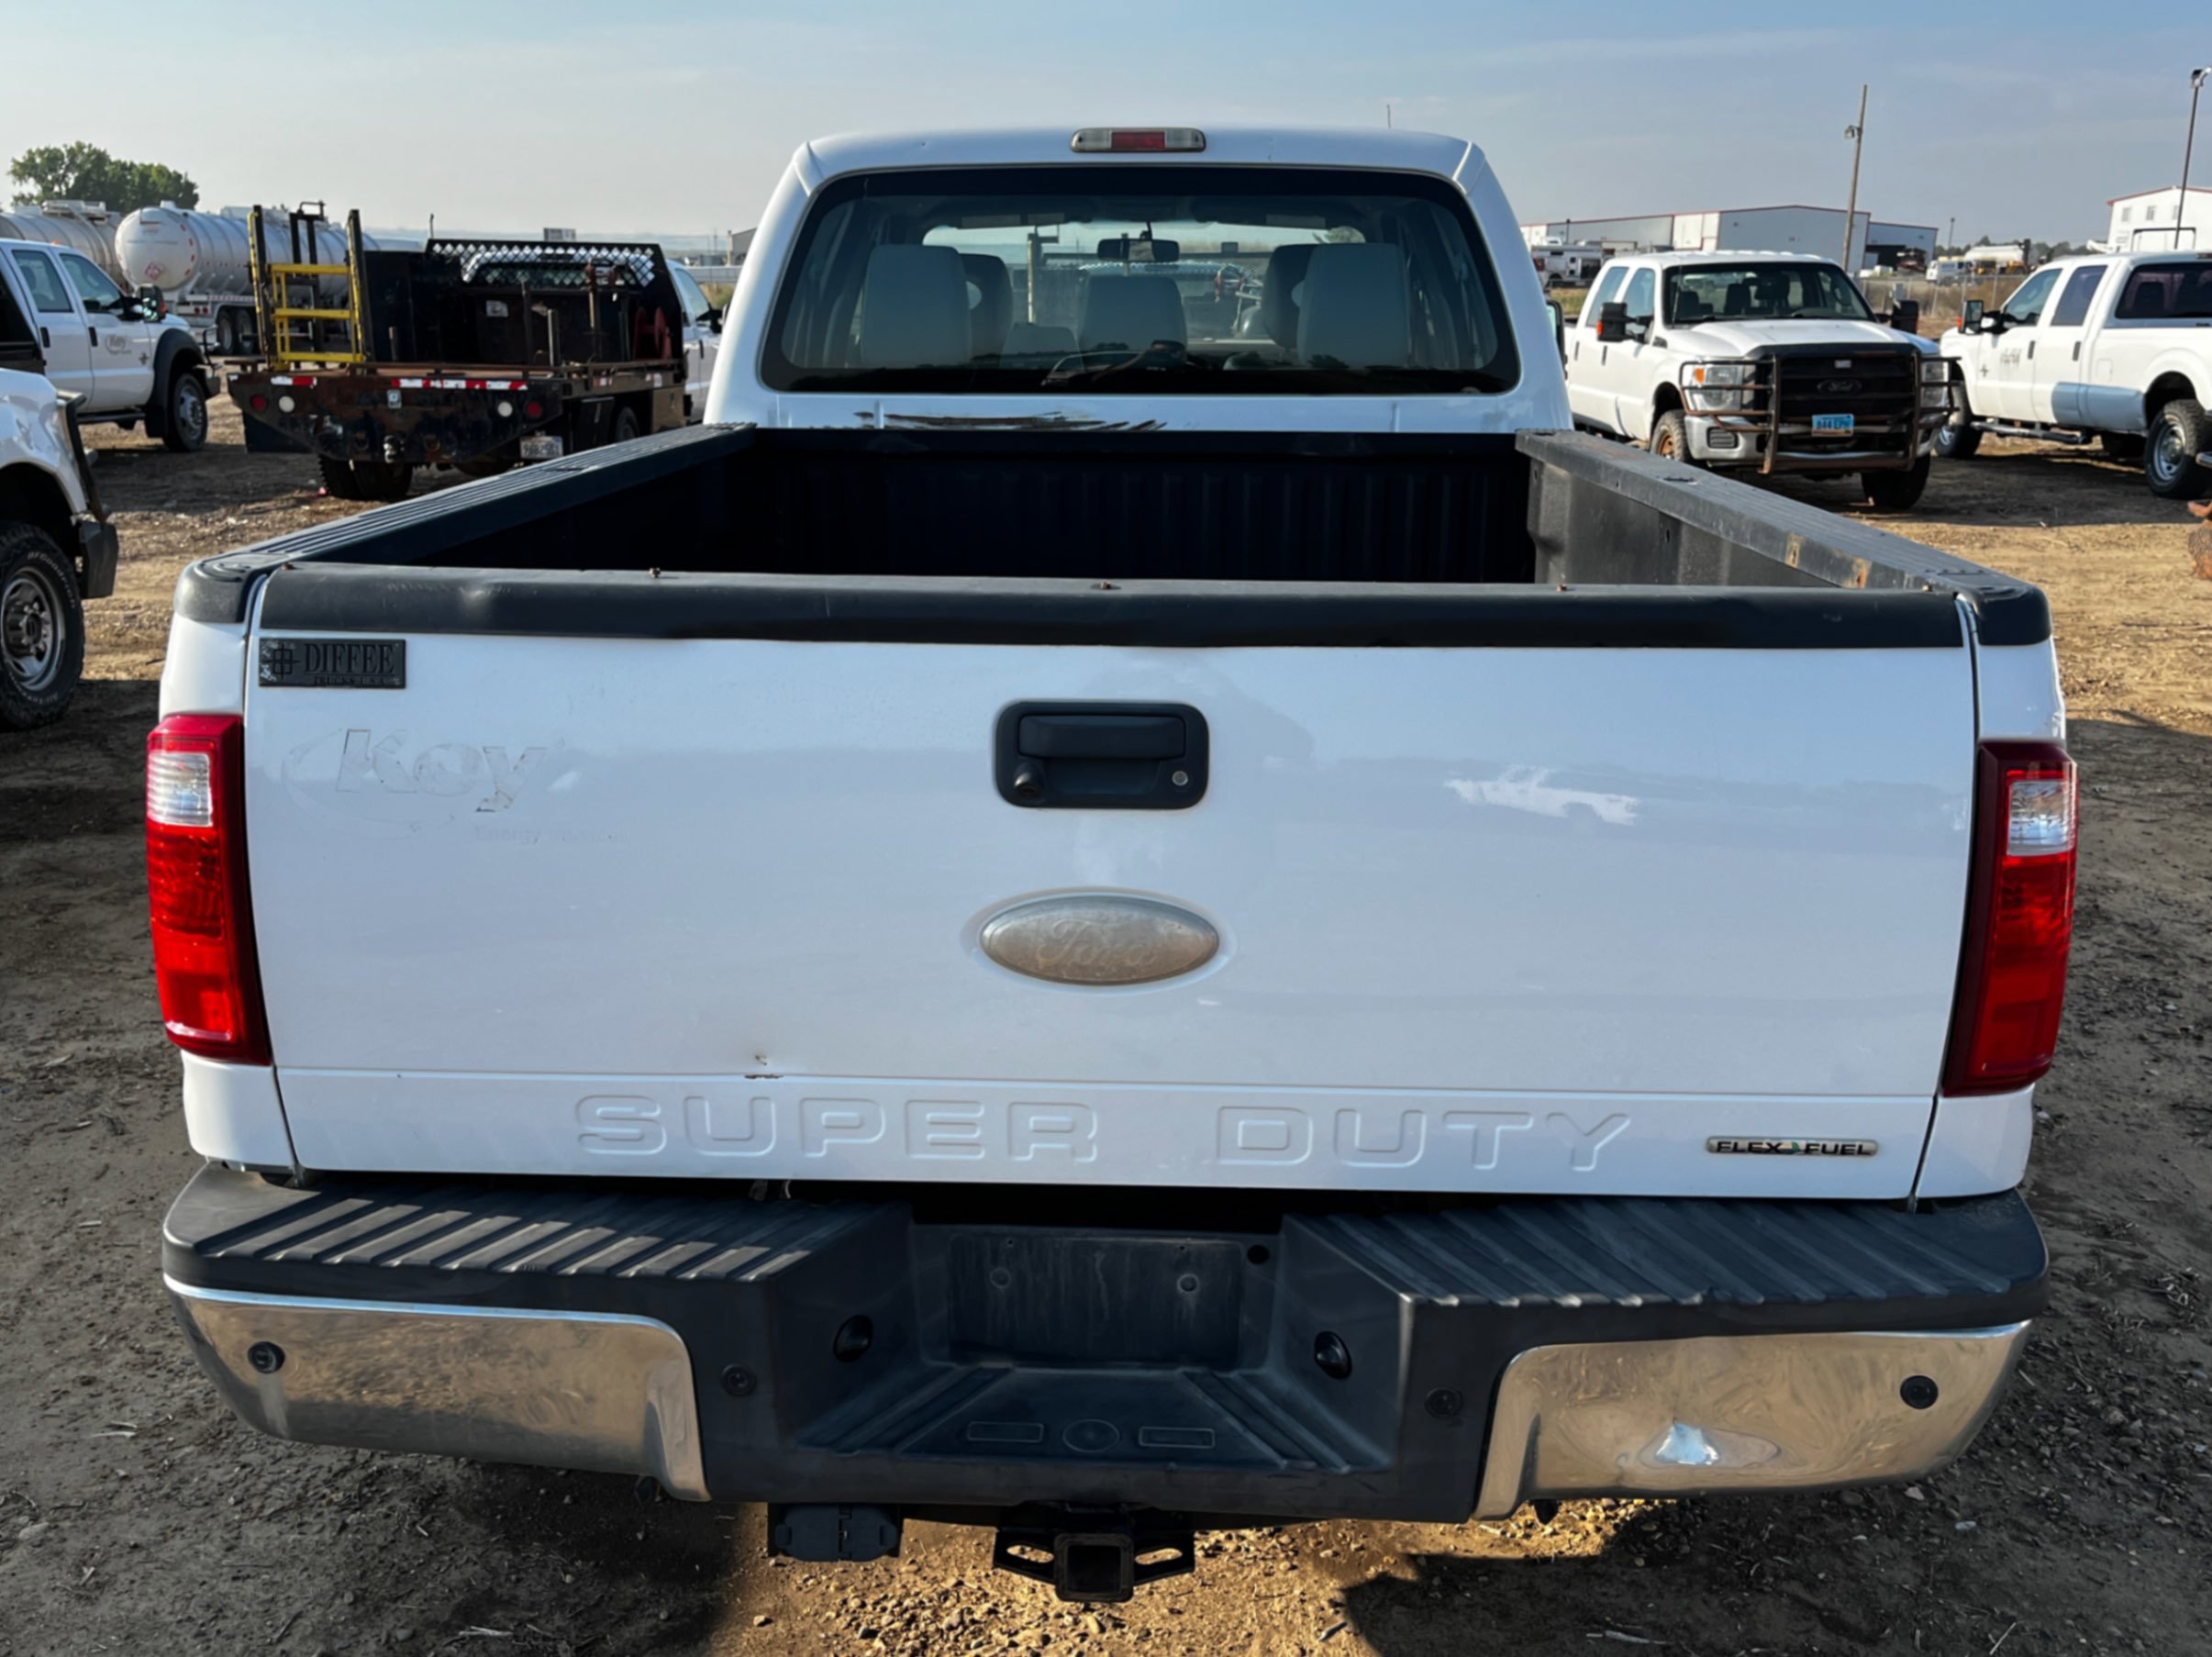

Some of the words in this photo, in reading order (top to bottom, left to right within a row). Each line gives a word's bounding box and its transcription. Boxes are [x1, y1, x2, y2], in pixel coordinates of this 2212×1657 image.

[304, 643, 395, 674] DIFFEE
[1035, 917, 1158, 969] Ford
[575, 1095, 1097, 1162] SUPER
[1217, 1106, 1631, 1172] DUTY
[1716, 1140, 1784, 1154] FLEX
[1804, 1142, 1873, 1156] FUEL
